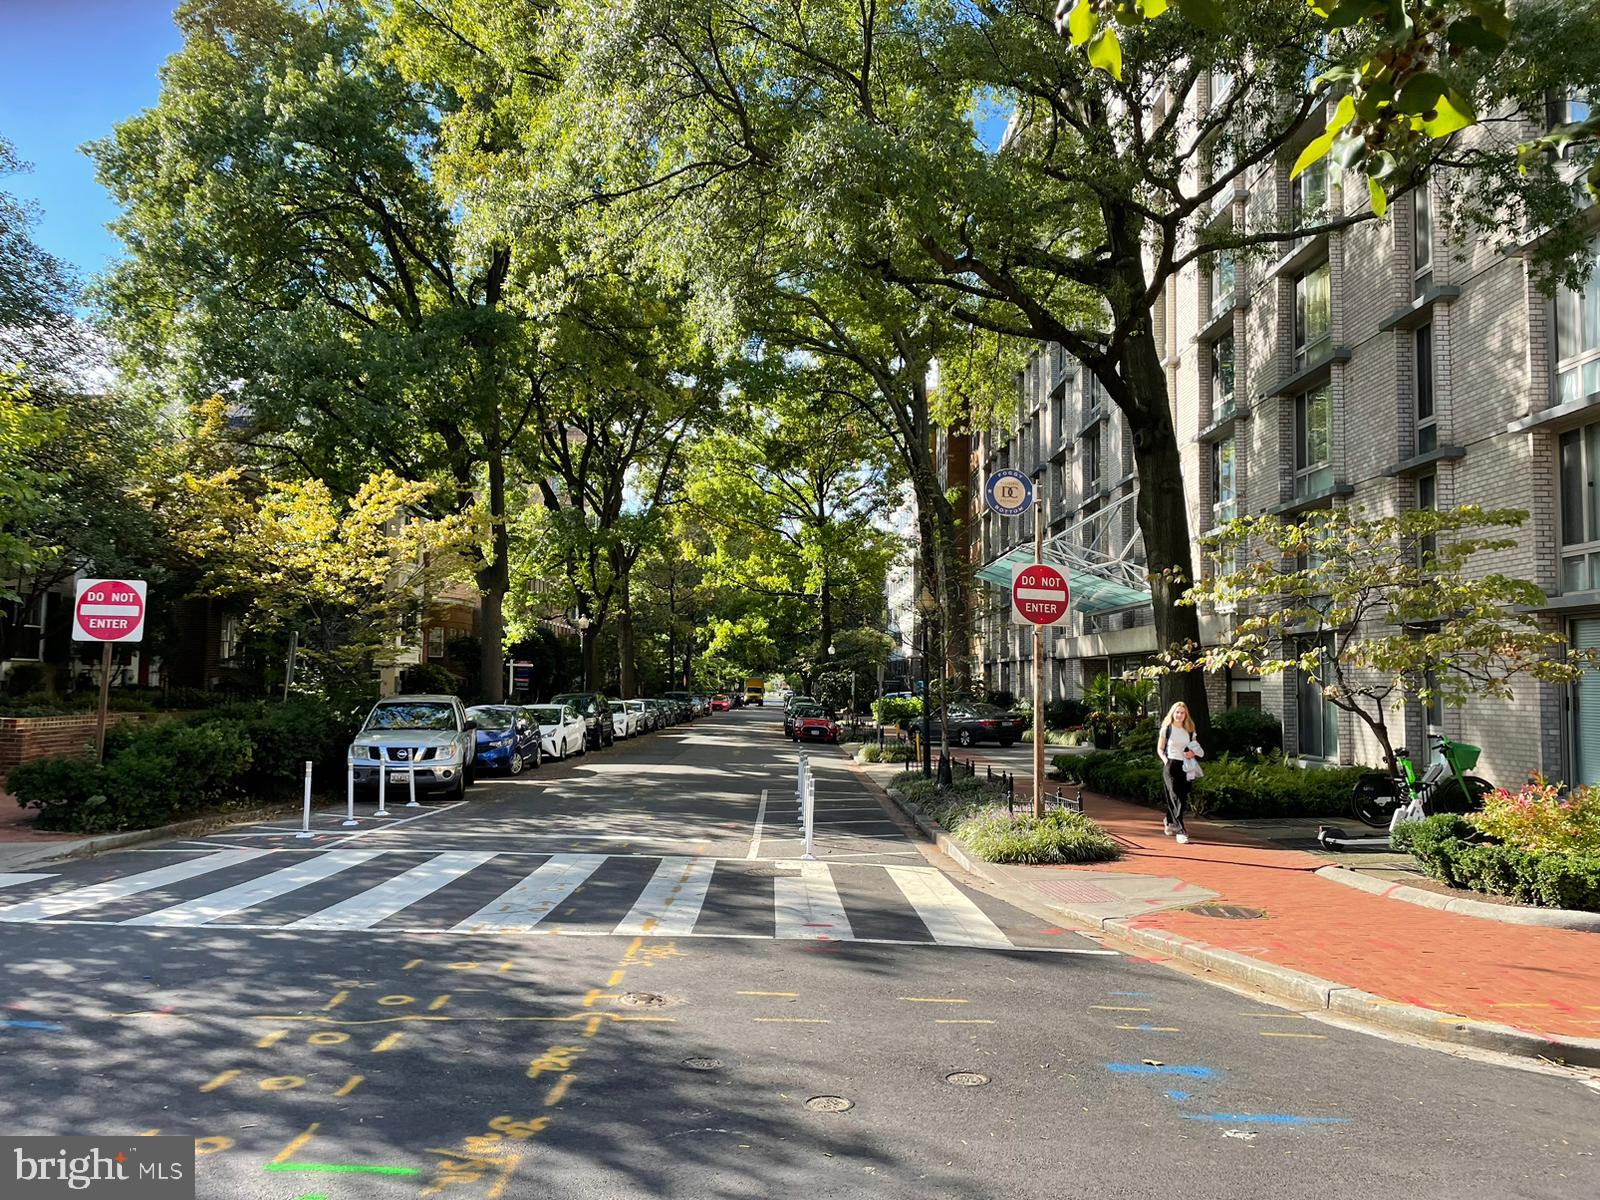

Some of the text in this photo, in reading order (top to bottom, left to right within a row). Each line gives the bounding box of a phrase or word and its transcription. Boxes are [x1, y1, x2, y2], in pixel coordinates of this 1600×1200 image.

[997, 470, 1023, 479] FOGGY
[994, 504, 1024, 515] BOTTOM
[1021, 575, 1061, 588] DO NOT
[87, 591, 136, 603] DO NOT
[1025, 602, 1057, 614] ENTER
[89, 618, 128, 629] ENTER
